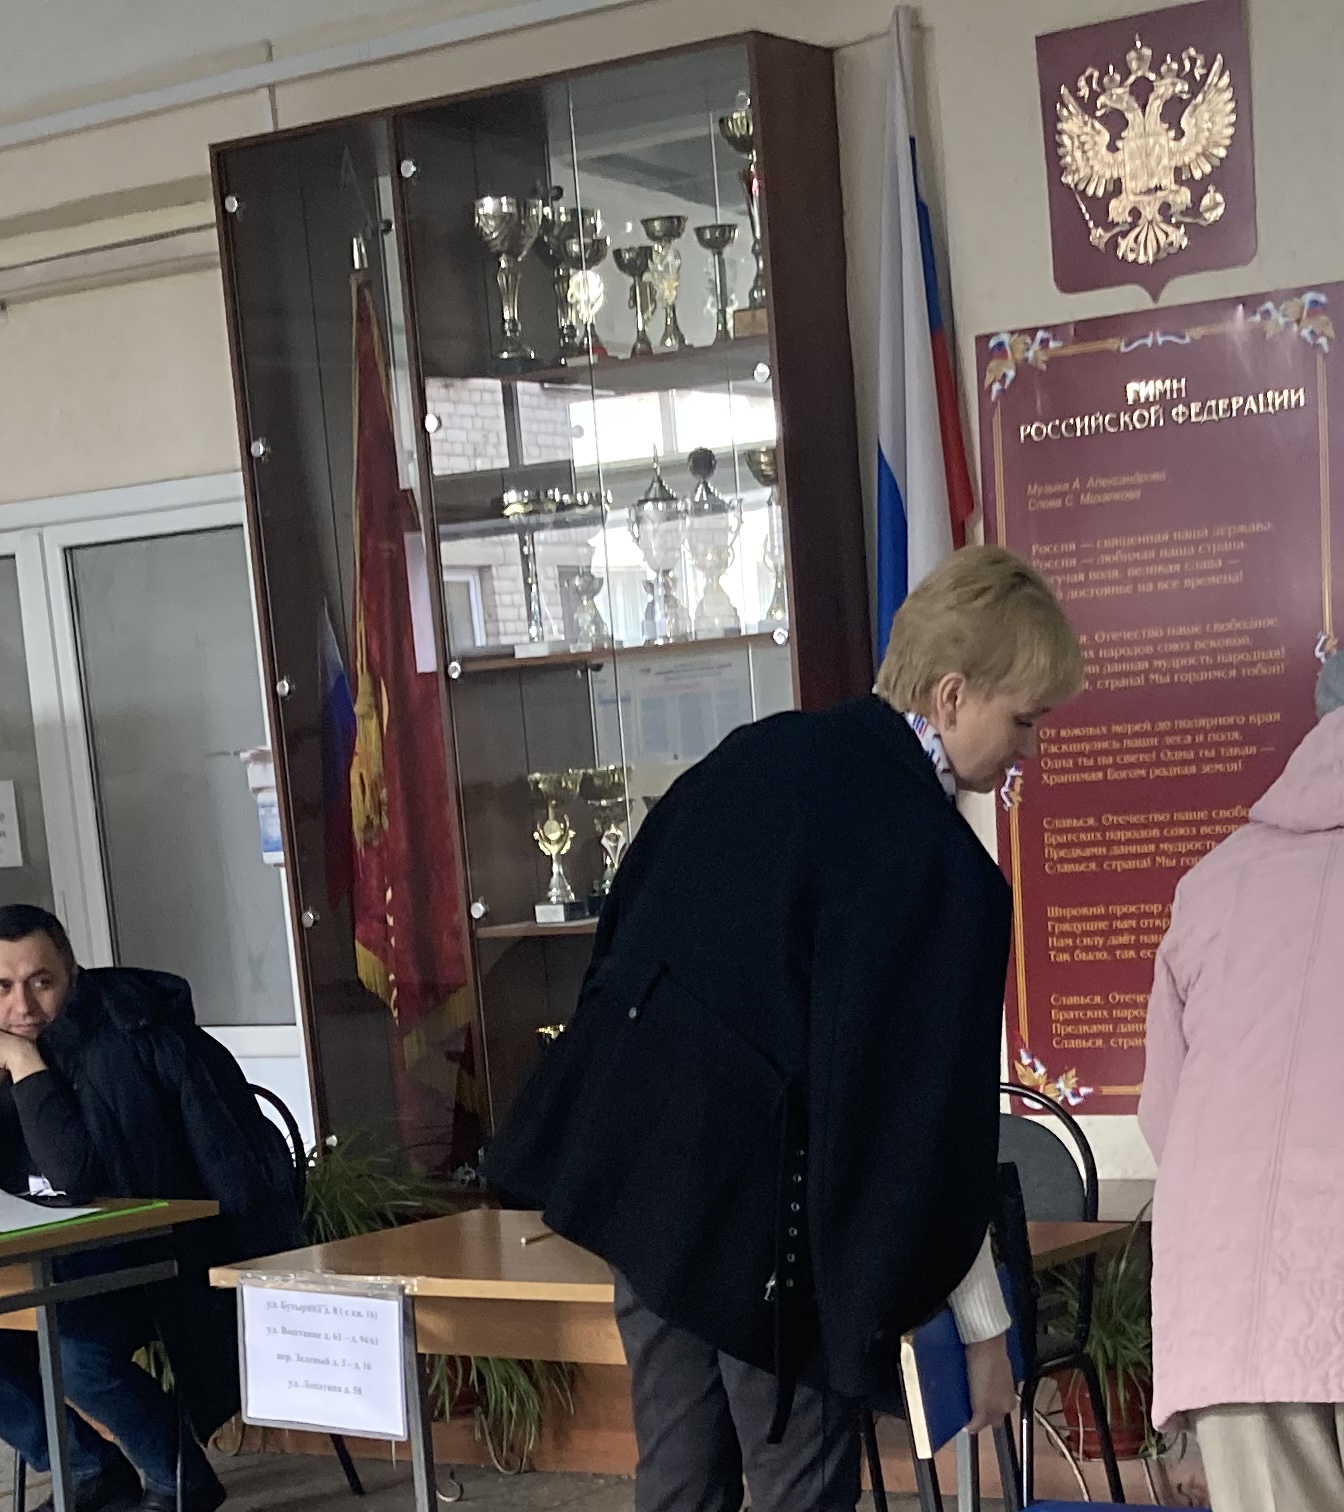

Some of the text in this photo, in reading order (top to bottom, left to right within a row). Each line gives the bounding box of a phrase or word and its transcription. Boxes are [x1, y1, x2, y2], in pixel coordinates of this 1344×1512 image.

[1125, 376, 1187, 405] ГИМН
[1019, 387, 1306, 443] РОССИЙСКОЙ ФЕДЕРАЦИИ
[1212, 805, 1249, 819] свобо
